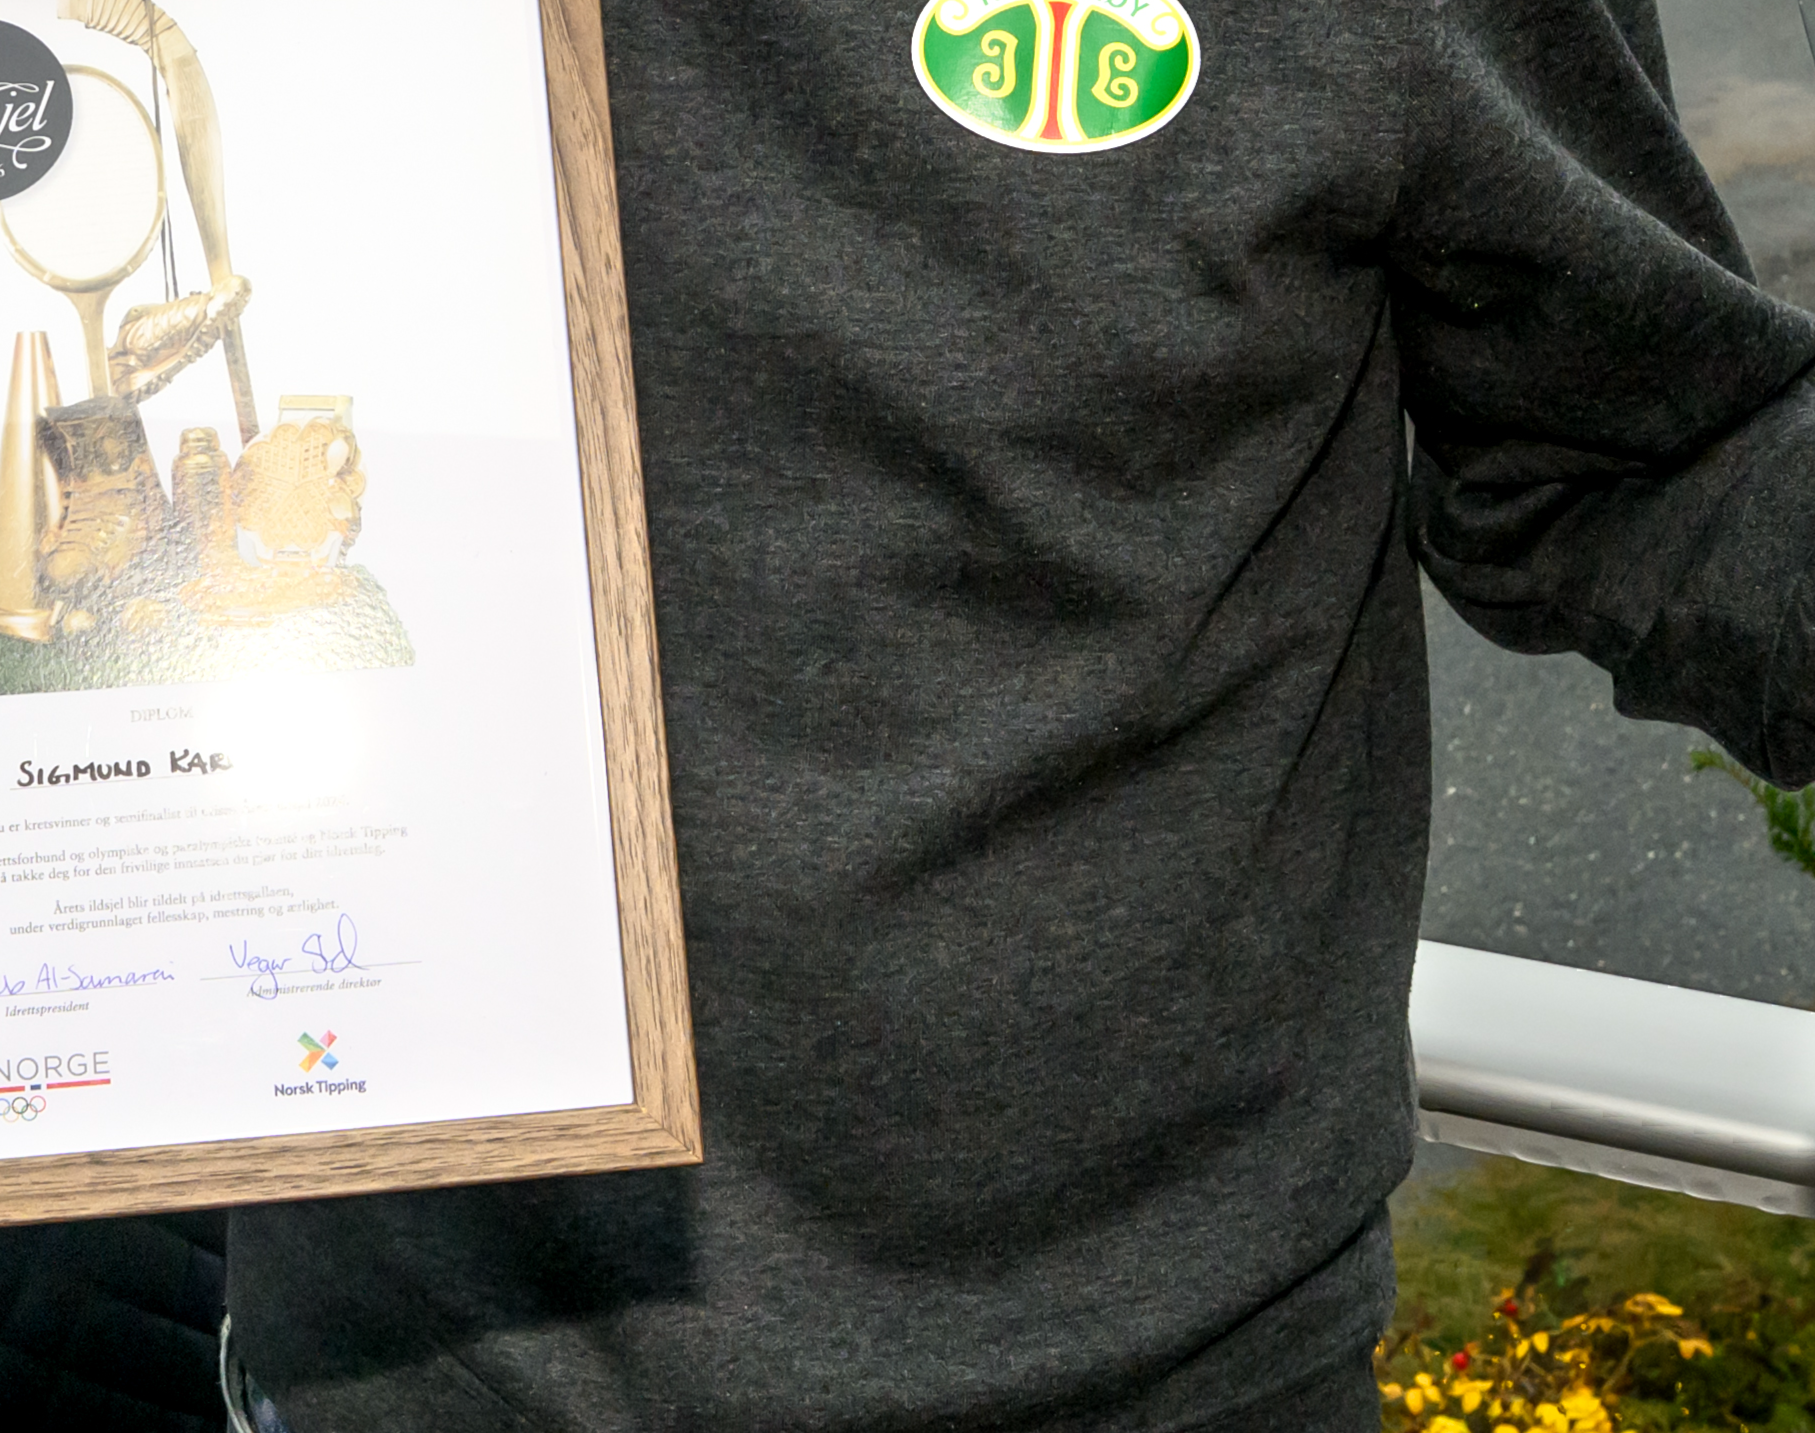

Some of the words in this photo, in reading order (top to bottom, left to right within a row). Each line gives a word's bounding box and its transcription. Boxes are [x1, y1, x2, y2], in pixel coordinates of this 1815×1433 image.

[17, 759, 151, 787] SIGMUND
[169, 748, 234, 775] KAR
[8, 822, 20, 833] er
[24, 816, 92, 832] kretsvinner
[95, 815, 111, 827] og
[113, 806, 182, 825] semifinalist
[70, 851, 86, 864] og
[88, 842, 150, 862] olympiske
[153, 843, 169, 857] og
[360, 822, 408, 841] Tipping
[0, 871, 7, 883] å
[11, 868, 45, 883] takke
[48, 866, 70, 882] deg
[73, 862, 91, 878] for
[95, 861, 116, 876] den
[120, 857, 170, 875] frivillige
[233, 852, 249, 865] du
[280, 847, 298, 861] for
[301, 845, 323, 860] ditt
[53, 899, 86, 916] Årets
[88, 896, 125, 913] ildsjel
[127, 894, 148, 909] blir
[152, 891, 187, 907] tildelt
[191, 891, 206, 907] på
[209, 885, 294, 904] idrettsgallaen,
[9, 920, 44, 936] under
[48, 913, 143, 934] verdigrunnlaget
[146, 906, 209, 924] fellesskap,
[212, 904, 265, 921] mestring
[268, 905, 284, 918] og
[286, 897, 340, 915] ærlighet.
[246, 979, 335, 998] Administrerende
[338, 976, 383, 991] direktør
[4, 1000, 90, 1018] Idrettspresident
[274, 1079, 315, 1098] Norsk
[316, 1076, 367, 1098] Tipping
